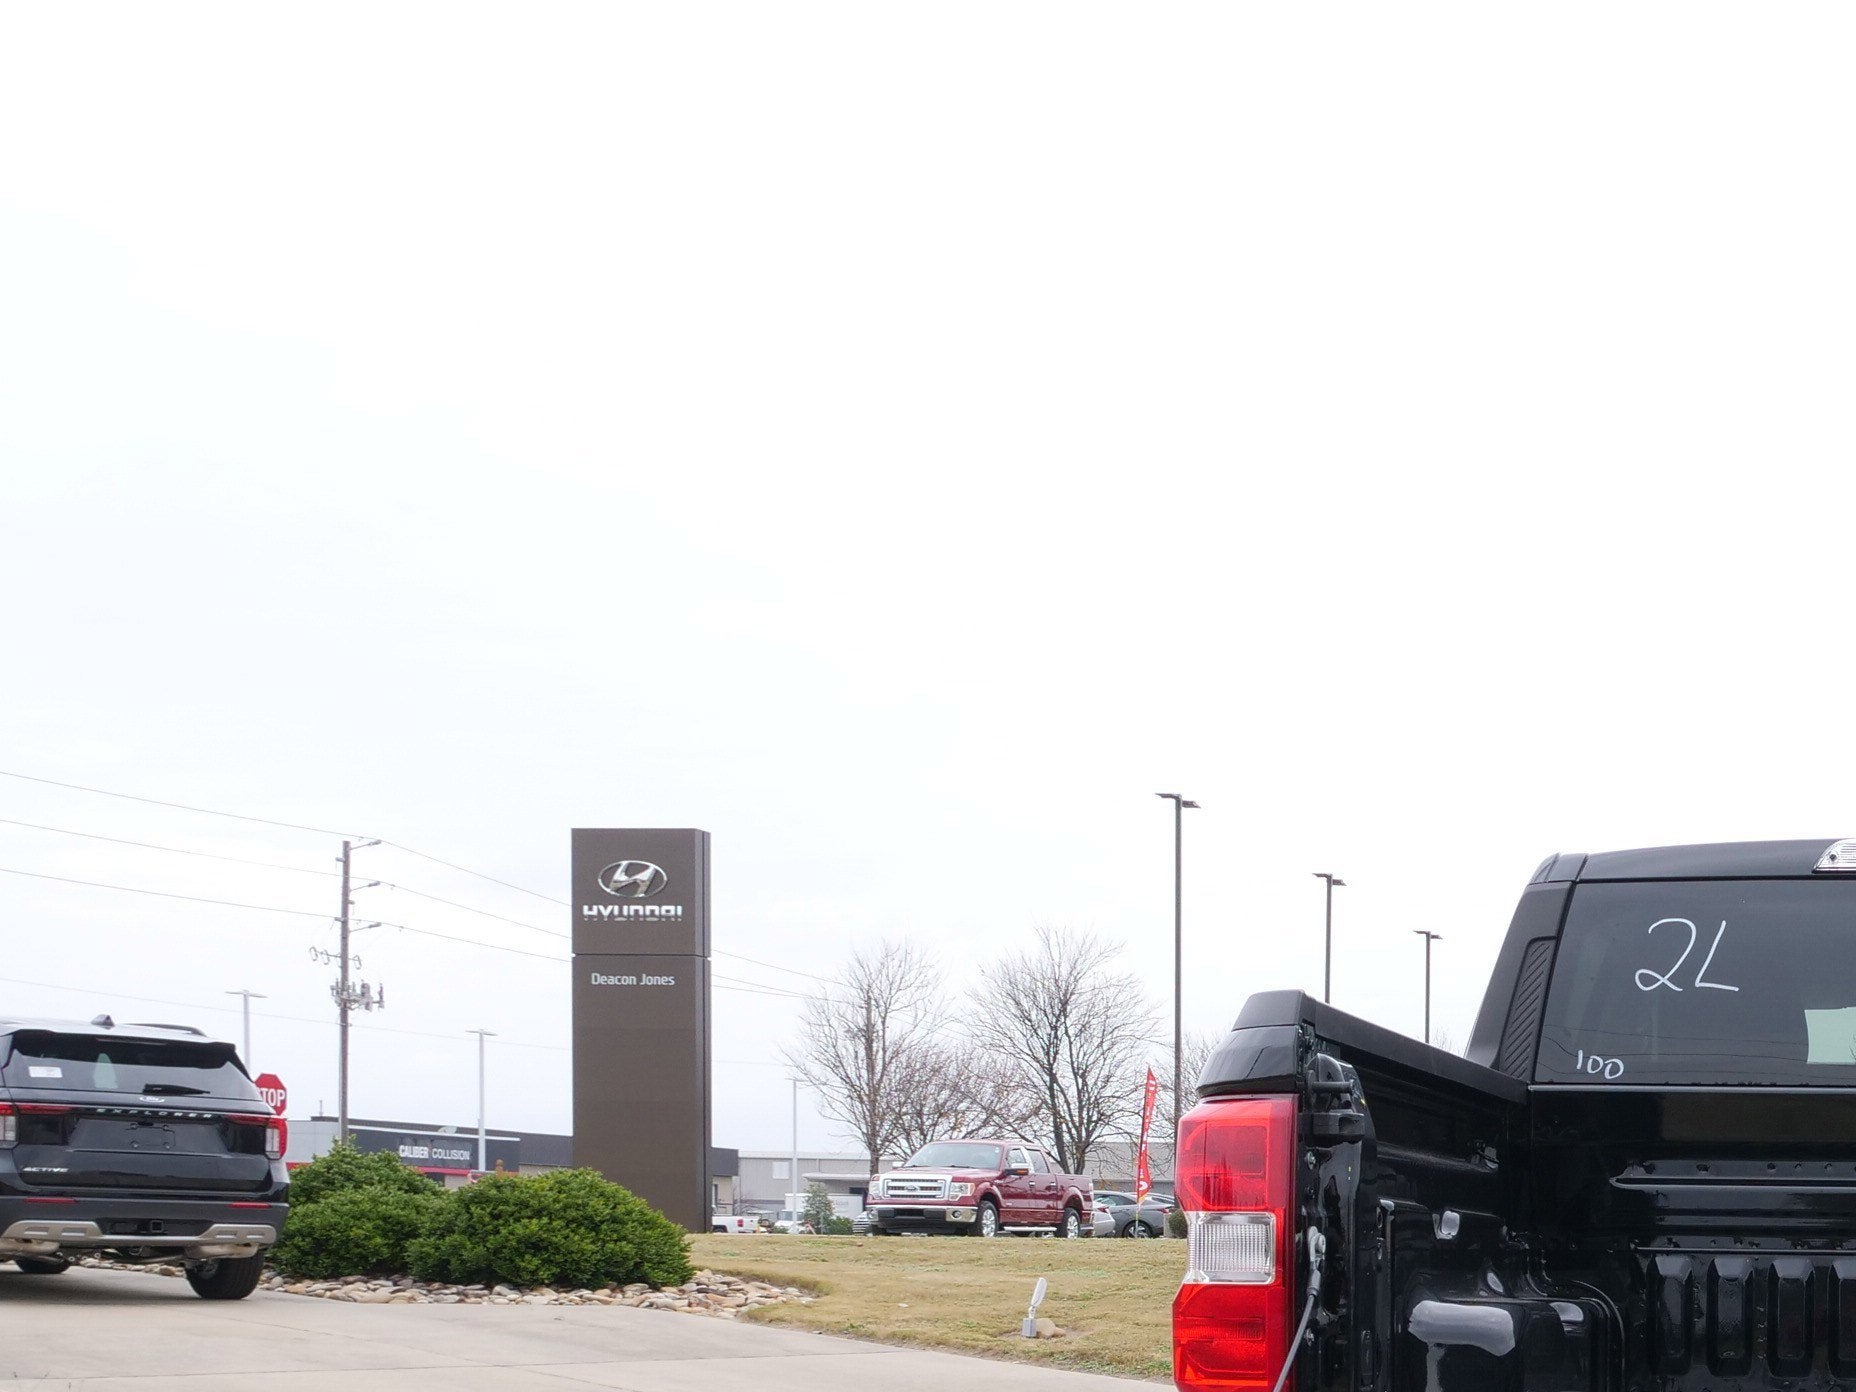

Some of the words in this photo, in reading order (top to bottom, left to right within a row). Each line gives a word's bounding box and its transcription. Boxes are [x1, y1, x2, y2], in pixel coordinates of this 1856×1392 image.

[582, 904, 683, 922] HYUNDAI
[1634, 917, 1740, 992] 2L
[591, 972, 637, 986] Deacon
[639, 972, 675, 986] Jones
[1576, 1049, 1625, 1079] 100
[257, 1087, 286, 1107] TOP
[399, 1145, 429, 1158] CALIBER
[432, 1148, 470, 1160] COLLISION
